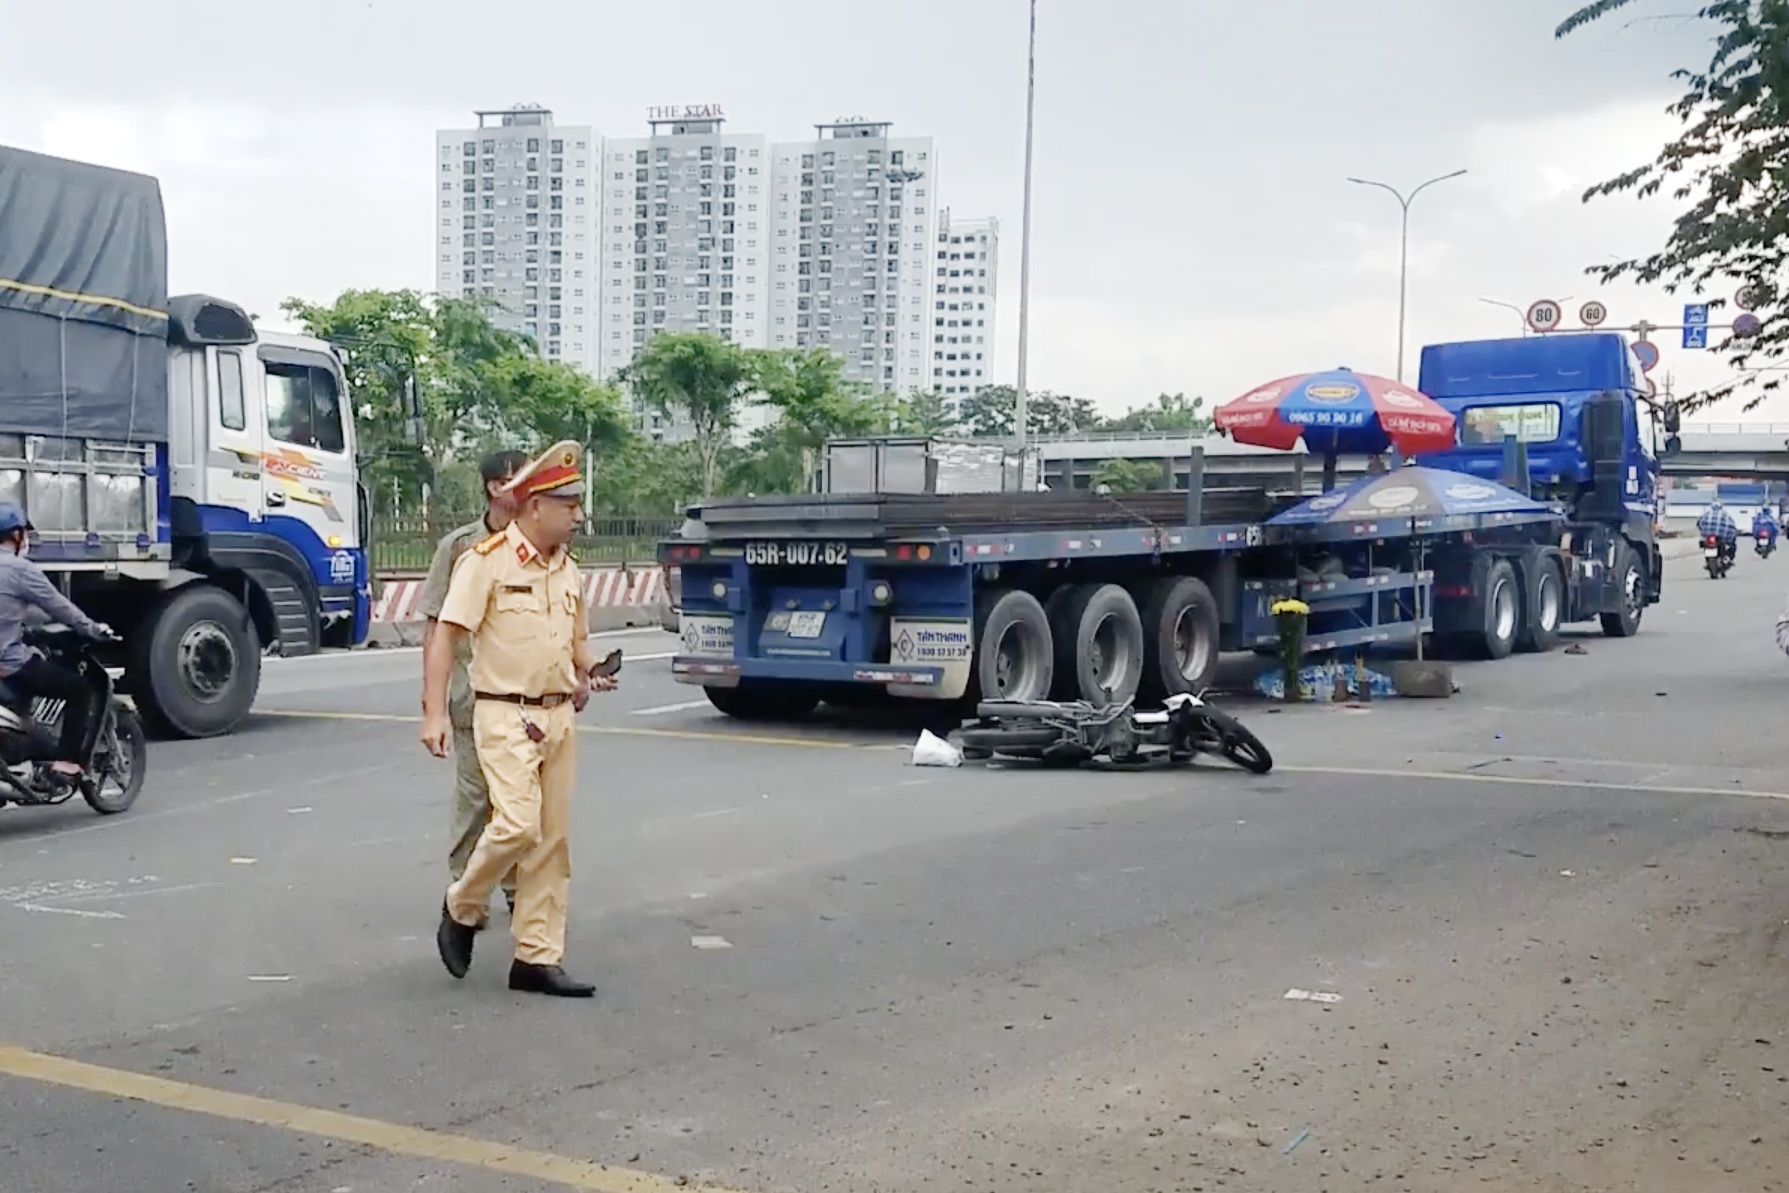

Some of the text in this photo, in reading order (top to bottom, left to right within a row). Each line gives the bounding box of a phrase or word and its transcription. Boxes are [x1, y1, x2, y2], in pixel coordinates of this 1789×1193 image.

[646, 104, 724, 118] THE STAR
[1535, 308, 1552, 322] 80
[1586, 308, 1600, 319] 60
[746, 543, 847, 565] 65R-007.62
